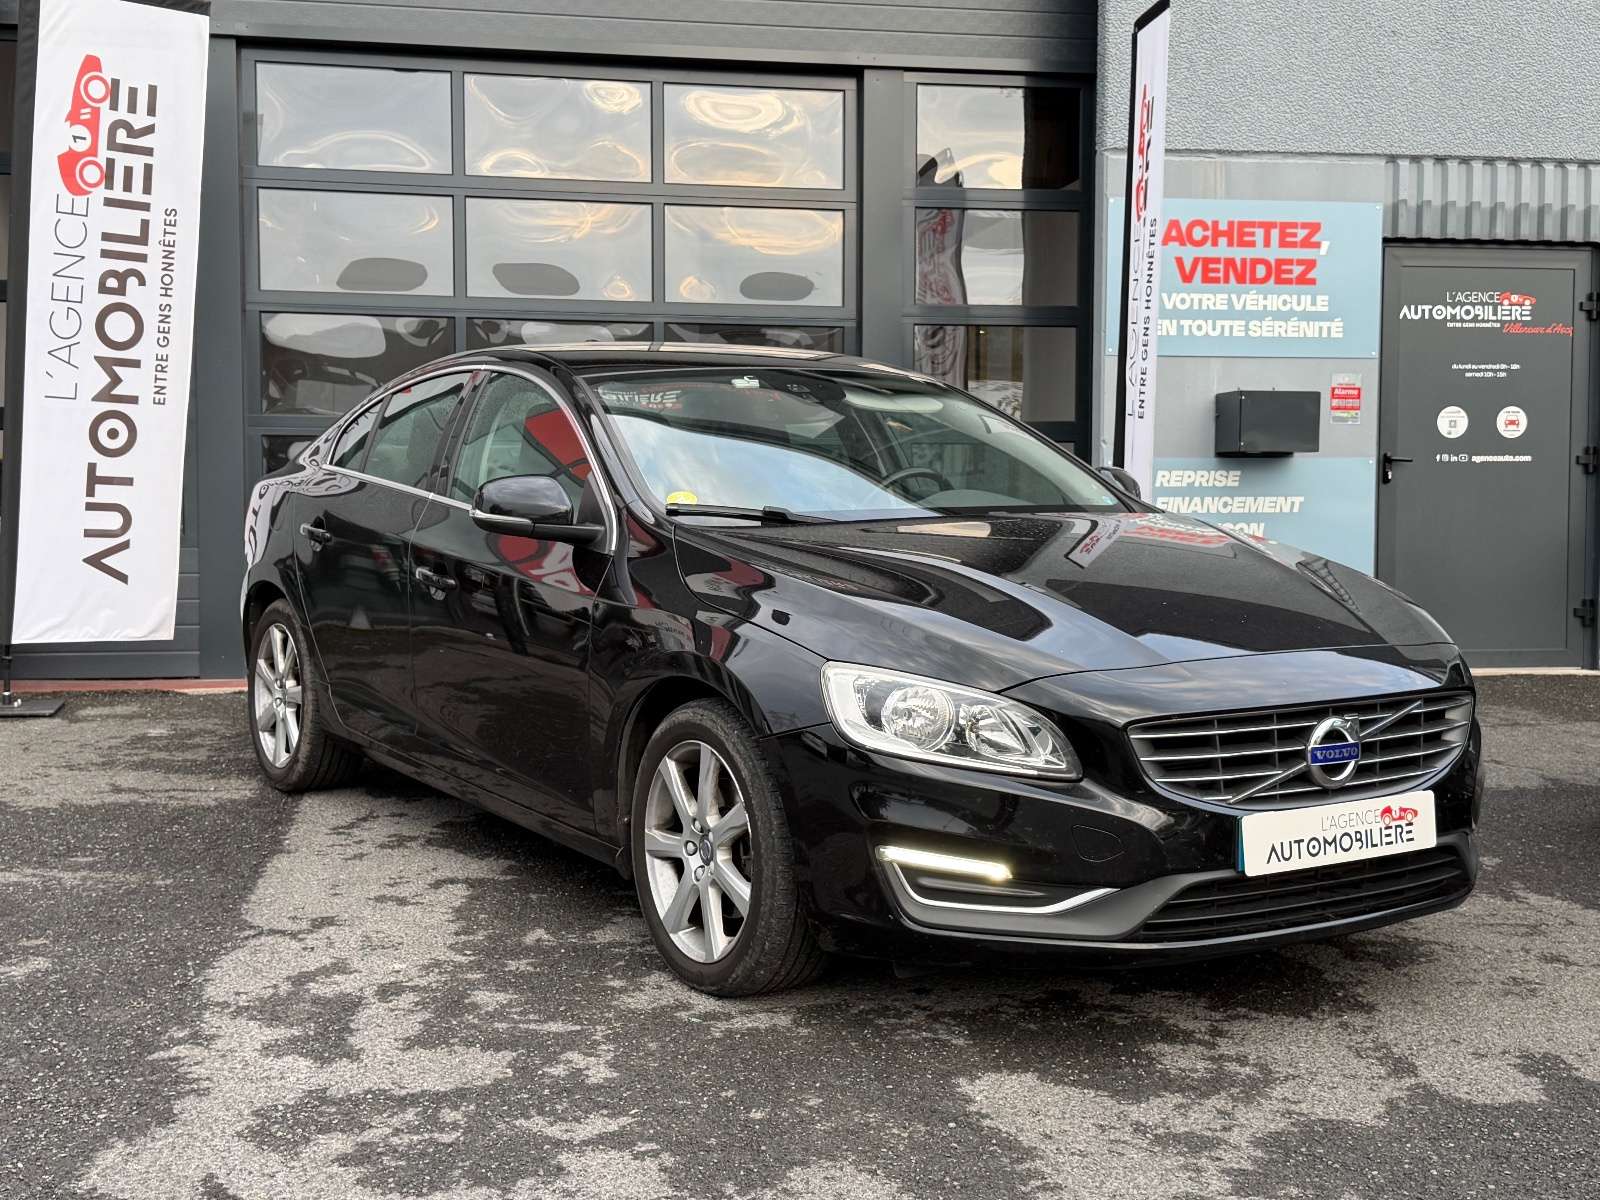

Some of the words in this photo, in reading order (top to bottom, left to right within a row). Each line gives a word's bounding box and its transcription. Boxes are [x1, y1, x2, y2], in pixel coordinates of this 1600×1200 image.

[158, 207, 178, 298] HONNÊTES
[1161, 219, 1330, 255] ACHETEZ,
[1145, 217, 1157, 310] HONNÊTES
[1174, 256, 1317, 286] VENDEZ
[44, 193, 89, 400] L'AGENCE
[1161, 293, 1228, 311] VOTRE
[1231, 290, 1329, 312] VÉHICULE
[1446, 291, 1500, 303] L'AGENCE
[156, 303, 172, 349] GENS
[1141, 316, 1151, 361] GENS
[1180, 319, 1248, 337] TOUTE
[1249, 316, 1344, 338] SÉRÉNITÉ
[153, 353, 169, 406] ENTRE
[1137, 366, 1148, 419] ENTRE
[1155, 470, 1241, 487] REPRISE
[1156, 496, 1304, 513] FINANCEMENT
[1315, 747, 1358, 760] VOLVO
[1321, 808, 1381, 831] L'AGENCE
